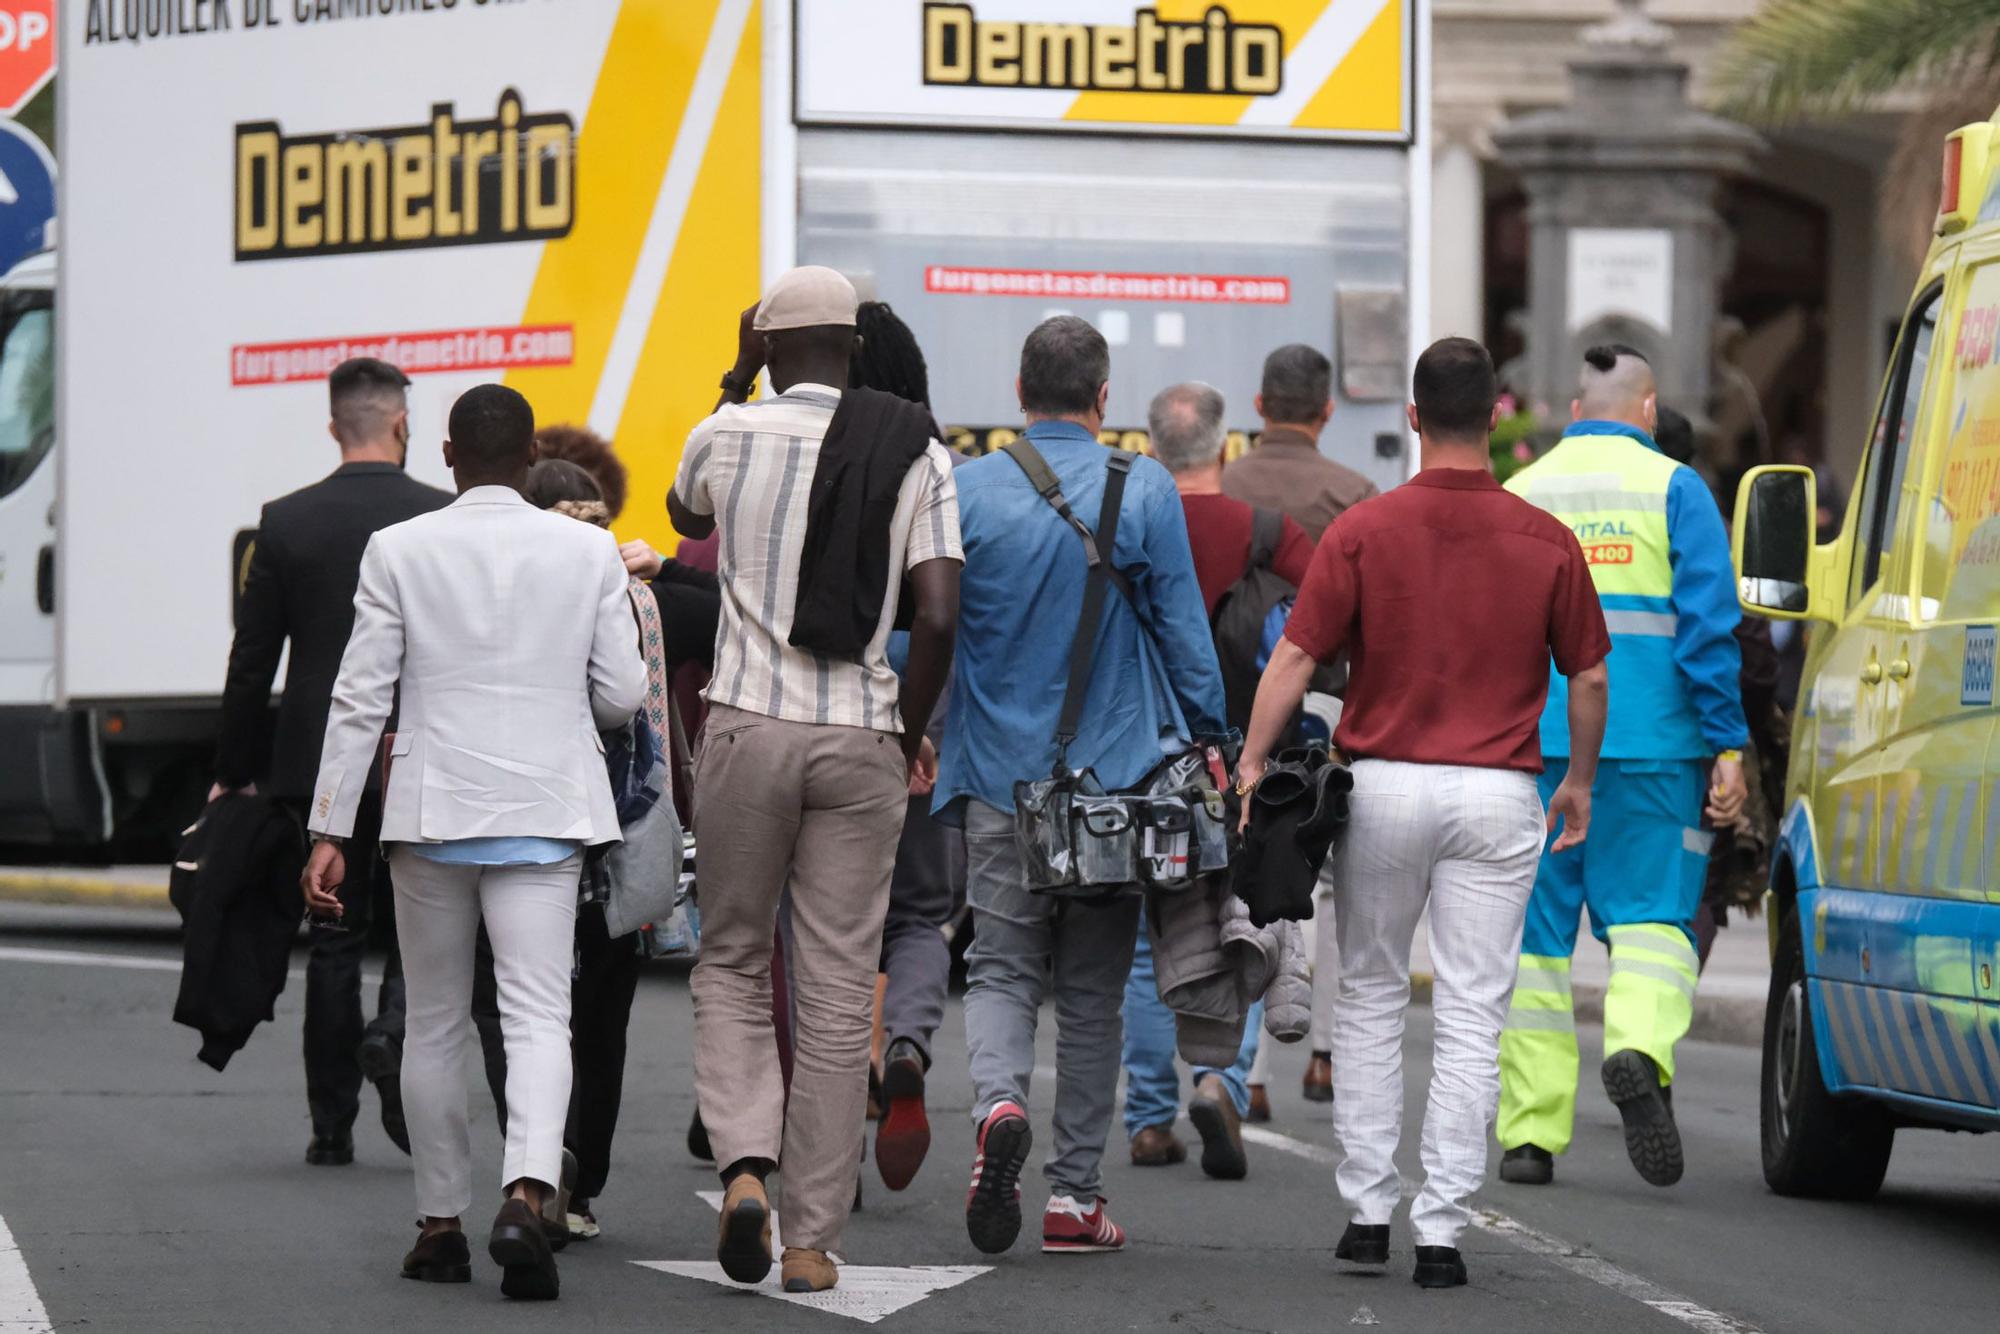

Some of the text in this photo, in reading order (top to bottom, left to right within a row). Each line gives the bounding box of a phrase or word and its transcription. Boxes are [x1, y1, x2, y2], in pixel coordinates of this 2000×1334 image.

[924, 4, 1281, 94] Demetrio
[236, 90, 575, 256] Demetrio
[930, 266, 1286, 300] furgonetasdemetrio.com
[1595, 545, 1629, 562] 400
